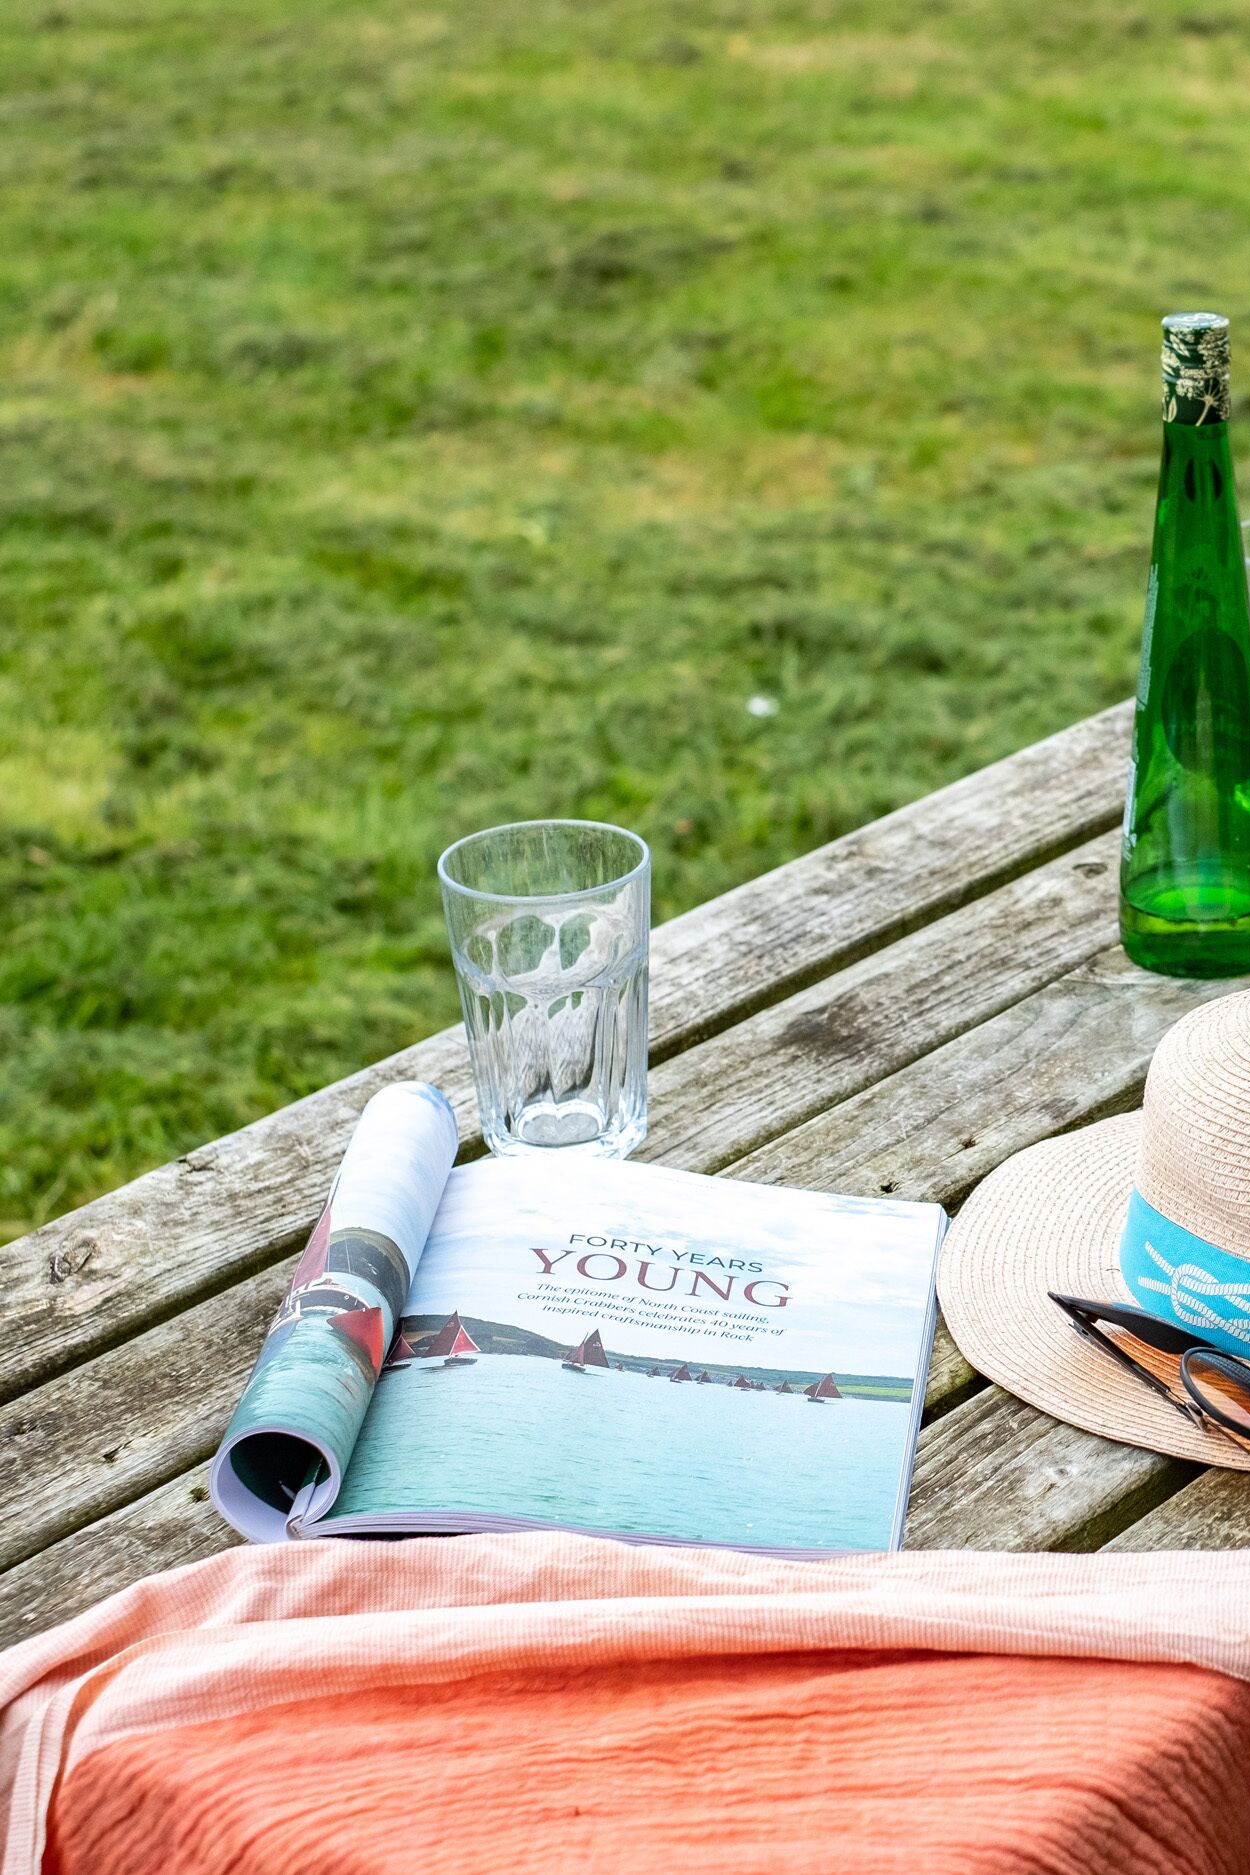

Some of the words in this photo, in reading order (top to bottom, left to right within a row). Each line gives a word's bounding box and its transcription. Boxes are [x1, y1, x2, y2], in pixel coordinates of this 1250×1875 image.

[569, 1233, 663, 1256] FORTY
[672, 1249, 763, 1273] YEARS
[529, 1247, 794, 1308] YOUNG
[517, 1292, 571, 1304] Cornish
[573, 1297, 636, 1314] Crabbers
[638, 1309, 707, 1325] celebrates
[710, 1320, 729, 1328] 40
[729, 1323, 770, 1334] years
[770, 1327, 787, 1336] of
[537, 1283, 561, 1292] The
[564, 1287, 620, 1300] epitome
[622, 1296, 638, 1304] of
[639, 1298, 678, 1311] North
[681, 1305, 721, 1316] Coast
[723, 1311, 770, 1324] sailing,
[542, 1304, 599, 1318] inspired
[601, 1313, 701, 1336] craftsmanship
[703, 1328, 717, 1337] in
[720, 1331, 756, 1342] Rock
